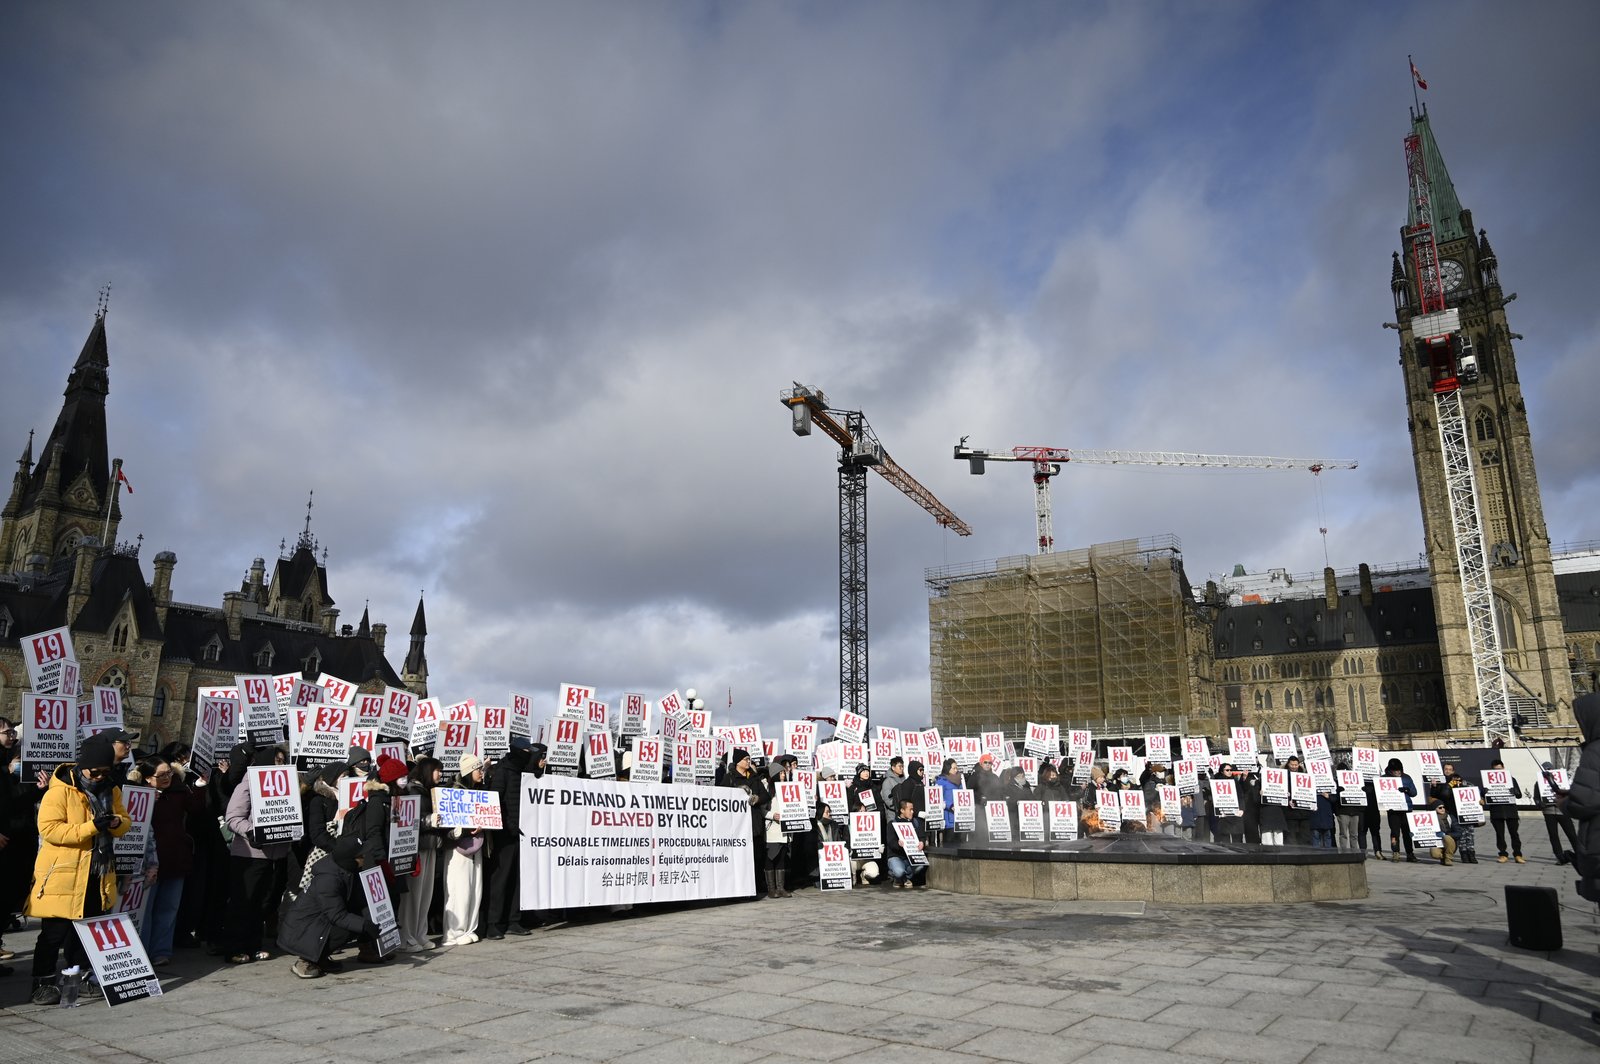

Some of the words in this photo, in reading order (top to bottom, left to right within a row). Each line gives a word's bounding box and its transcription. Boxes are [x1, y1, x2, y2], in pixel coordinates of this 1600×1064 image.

[38, 635, 61, 663] 19
[38, 672, 61, 683] WAITING
[249, 680, 269, 703] 42
[274, 677, 293, 696] 25
[102, 692, 117, 714] 19
[300, 685, 318, 706] 35
[569, 688, 584, 707] 31
[363, 698, 381, 717] 19
[391, 693, 409, 718] 42
[450, 704, 468, 721] 22
[515, 696, 527, 716] 34
[628, 696, 640, 715] 53
[664, 696, 680, 715] 33
[38, 700, 64, 730] 30
[202, 704, 216, 735] 20
[317, 708, 344, 733] 32
[487, 709, 503, 728] 31
[590, 703, 604, 724] 15
[259, 719, 279, 727] RESPONSE
[665, 718, 676, 737] 68
[844, 715, 860, 730] 43
[37, 733, 64, 741] MONTHS
[447, 725, 465, 746] 31
[559, 721, 574, 743] 11
[740, 728, 755, 743] 33
[925, 732, 937, 747] 63
[1033, 726, 1046, 741] 70
[1074, 732, 1087, 745] 36
[30, 742, 56, 750] WAITING
[57, 742, 70, 750] FOR
[307, 740, 331, 748] WAITING
[352, 731, 370, 752] 37
[591, 734, 607, 756] 71
[793, 735, 807, 750] 34
[906, 734, 918, 746] 11
[951, 740, 961, 752] 27
[987, 734, 999, 747] 16
[1151, 736, 1164, 748] 90
[1188, 741, 1201, 752] 39
[1235, 741, 1248, 752] 38
[1276, 736, 1290, 747] 30
[26, 750, 41, 759] IRCC
[40, 751, 73, 759] RESPONSE
[641, 741, 658, 762] 53
[678, 746, 691, 765] 34
[697, 741, 711, 758] 68
[822, 745, 837, 760] 30
[845, 746, 861, 760] 55
[877, 742, 891, 756] 65
[1114, 749, 1126, 761] 37
[1359, 750, 1373, 762] 33
[928, 752, 941, 765] 72
[1312, 762, 1326, 774] 38
[263, 770, 287, 796] 40
[1267, 770, 1281, 784] 37
[1297, 775, 1310, 788] 37
[1343, 772, 1358, 784] 40
[1489, 772, 1505, 783] 30
[441, 788, 465, 802] STOP
[468, 790, 489, 803] THE
[783, 785, 800, 802] 41
[826, 784, 841, 798] 24
[1217, 782, 1230, 794] 37
[1460, 789, 1474, 801] 20
[265, 798, 289, 807] MONTHS
[528, 788, 555, 804] WE
[560, 789, 626, 808] DEMAND
[630, 795, 640, 808] A
[641, 795, 689, 810] TIMELY
[692, 797, 748, 813] DECISION
[958, 792, 970, 806] 35
[1126, 793, 1139, 806] 37
[129, 792, 146, 822] 20
[260, 807, 284, 815] WAITING
[400, 801, 413, 826] 40
[991, 804, 1004, 817] 18
[1025, 803, 1038, 817] 36
[1056, 804, 1072, 817] 21
[257, 816, 270, 824] IRCC
[270, 813, 299, 823] RESPONSE
[591, 810, 654, 827] DELAYED
[657, 814, 674, 828] BY
[677, 814, 707, 828] IRCC
[858, 815, 874, 831] 40
[1415, 814, 1432, 827] 22
[530, 837, 600, 847] REASONABLE
[601, 837, 650, 847] TIMELINES
[658, 838, 711, 847] PROCEDURAL
[712, 838, 747, 847] FAIRNESS
[557, 855, 589, 866] Délais
[591, 855, 650, 865] raisonnables
[658, 852, 684, 866] Équité
[685, 854, 729, 865] procédurale
[826, 845, 843, 861] 43
[602, 871, 648, 887] 给出时限
[659, 870, 700, 885] 程序公平
[95, 920, 126, 951] 11
[105, 950, 133, 962] MONTHS
[102, 960, 130, 973] WAITING
[130, 958, 143, 966] FOR
[102, 972, 118, 982] IRCC
[117, 965, 150, 979] RESPONSE
[114, 985, 123, 993] NO
[119, 991, 128, 1000] NO
